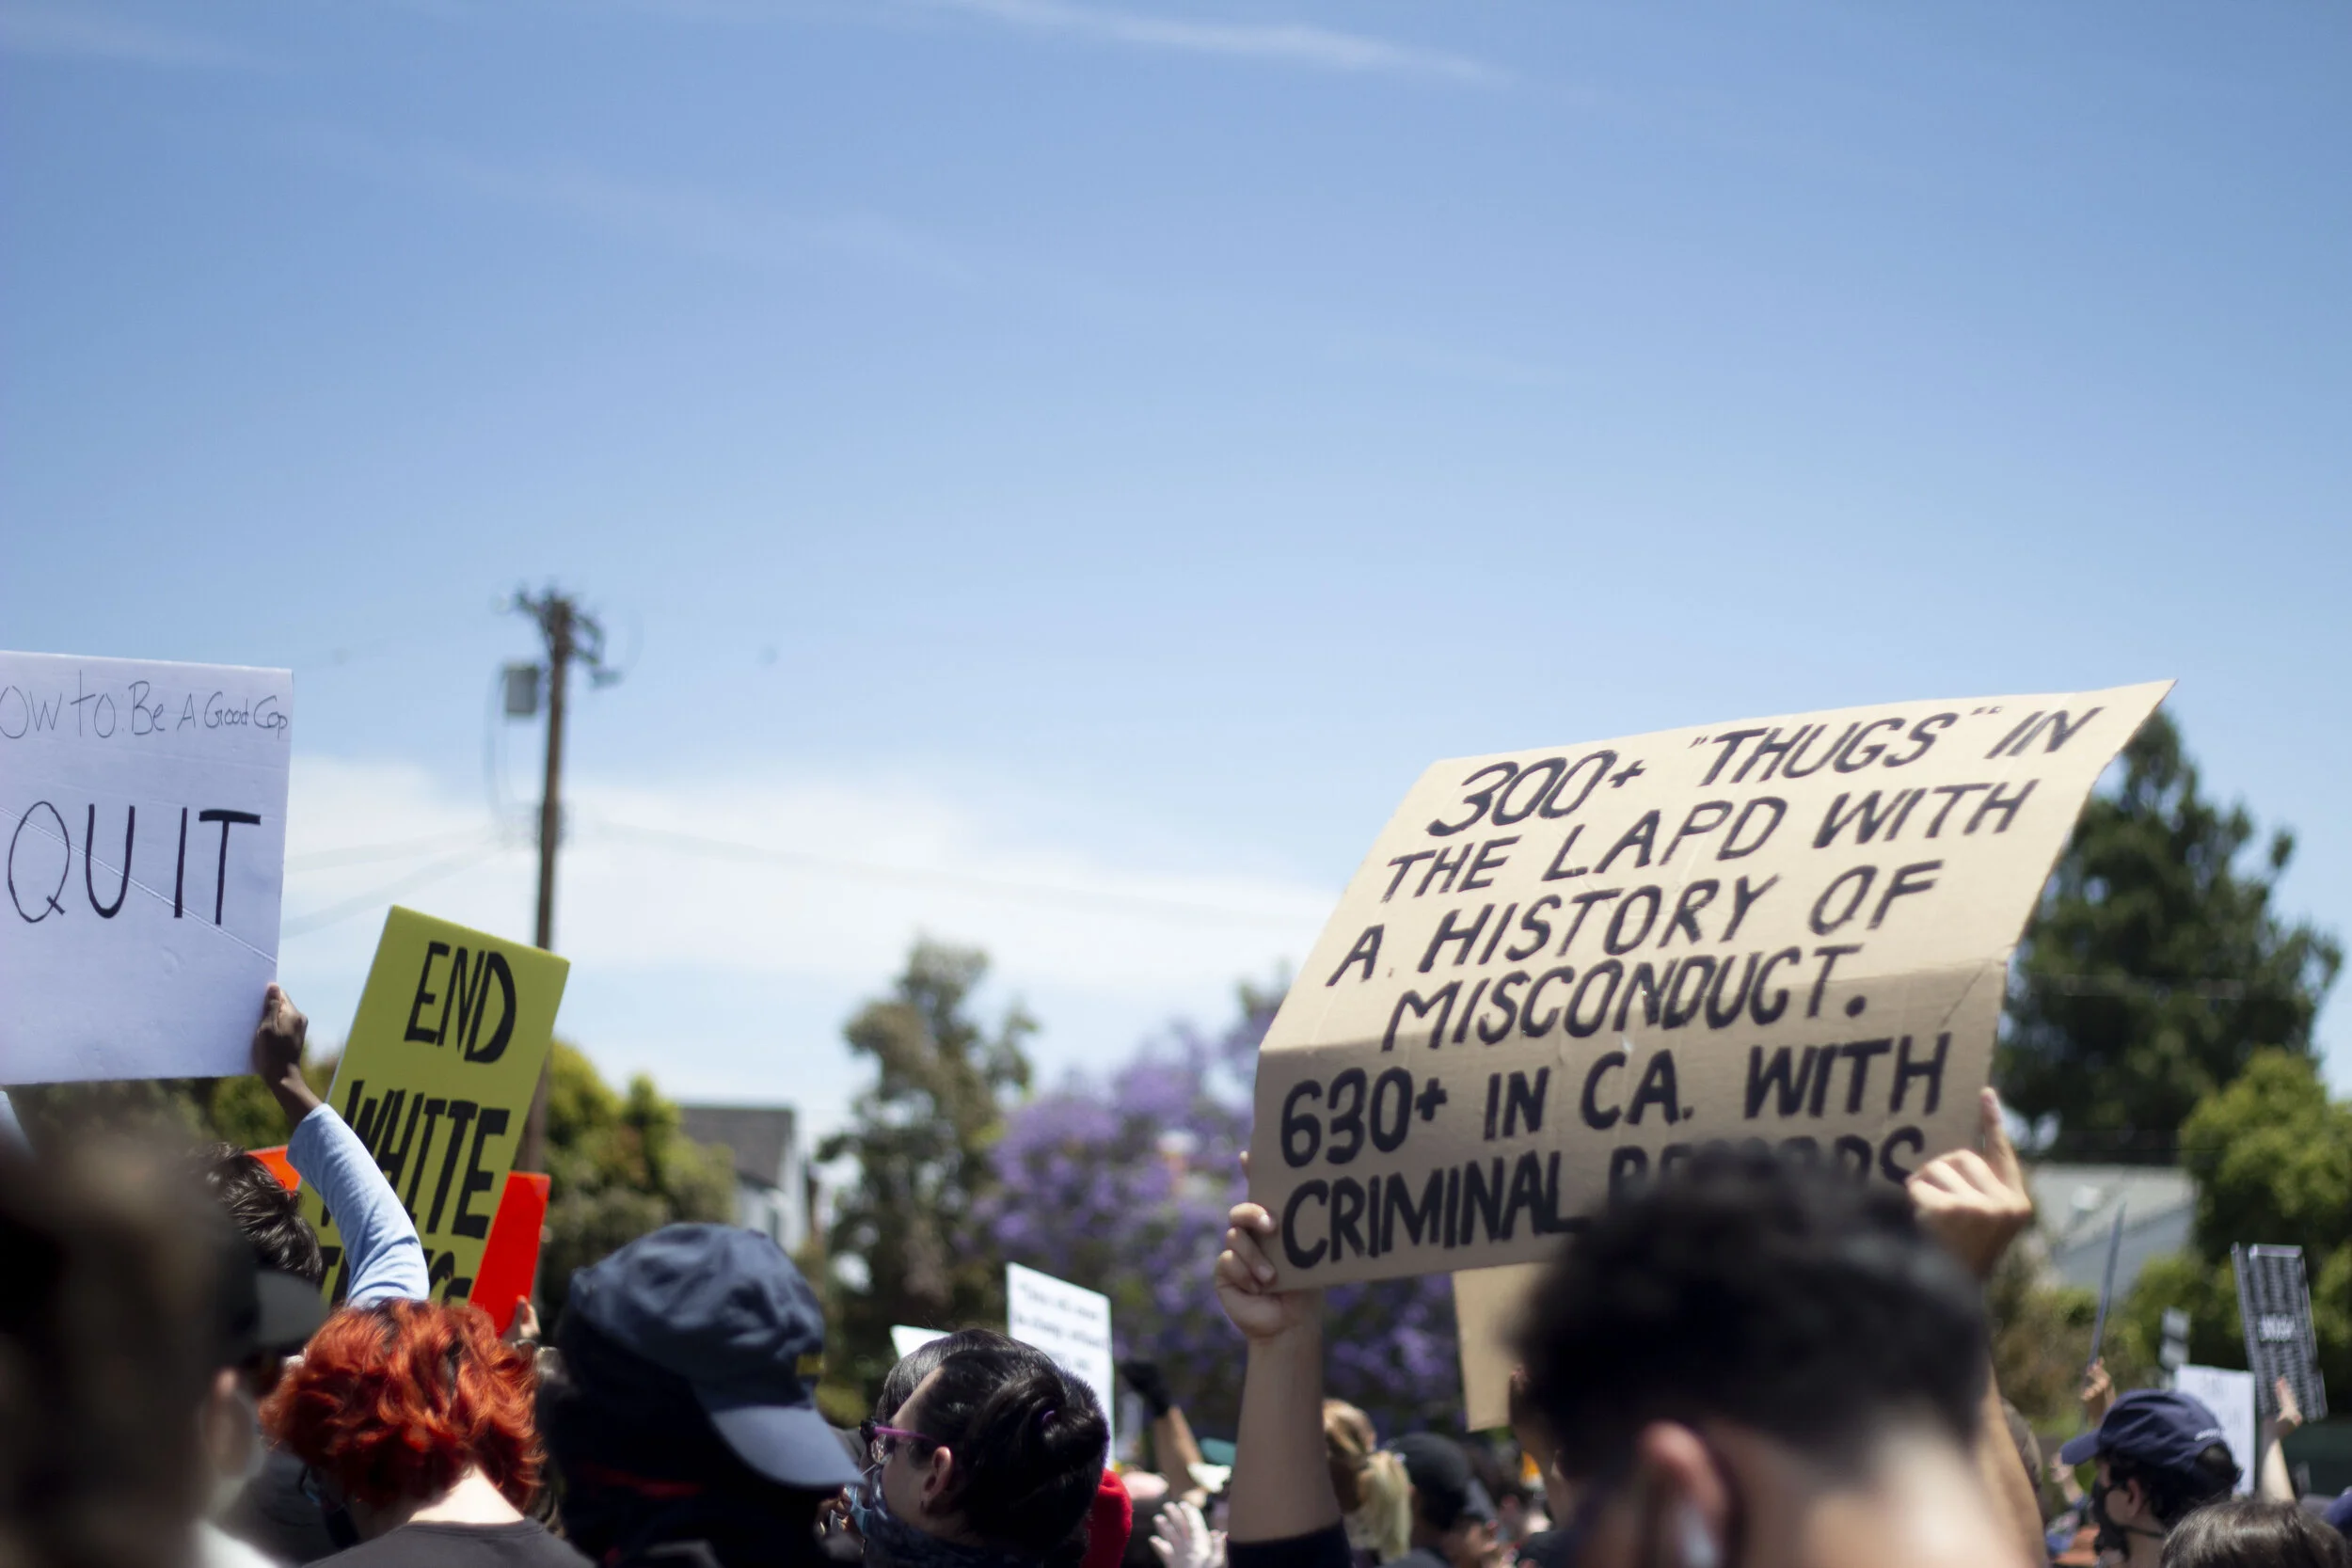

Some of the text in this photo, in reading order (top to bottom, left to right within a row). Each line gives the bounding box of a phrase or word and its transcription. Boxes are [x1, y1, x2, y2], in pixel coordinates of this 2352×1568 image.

[128, 680, 165, 736] Be
[177, 693, 196, 731] A
[204, 690, 248, 728] Good
[254, 695, 288, 739] Cop
[1425, 750, 1647, 836] 300+
[1984, 706, 2106, 759] IN
[8, 800, 261, 925] QUIT
[1380, 778, 2040, 903] THE LAPD WITH
[1418, 874, 1780, 973] HISTORY
[1808, 860, 1945, 935] OF
[404, 942, 516, 1064] END
[1382, 943, 1867, 1052] MISCONDUCT.
[1281, 1032, 1951, 1168] 630+ IN CA. WITH
[1282, 1149, 1590, 1269] CRIMINAL
